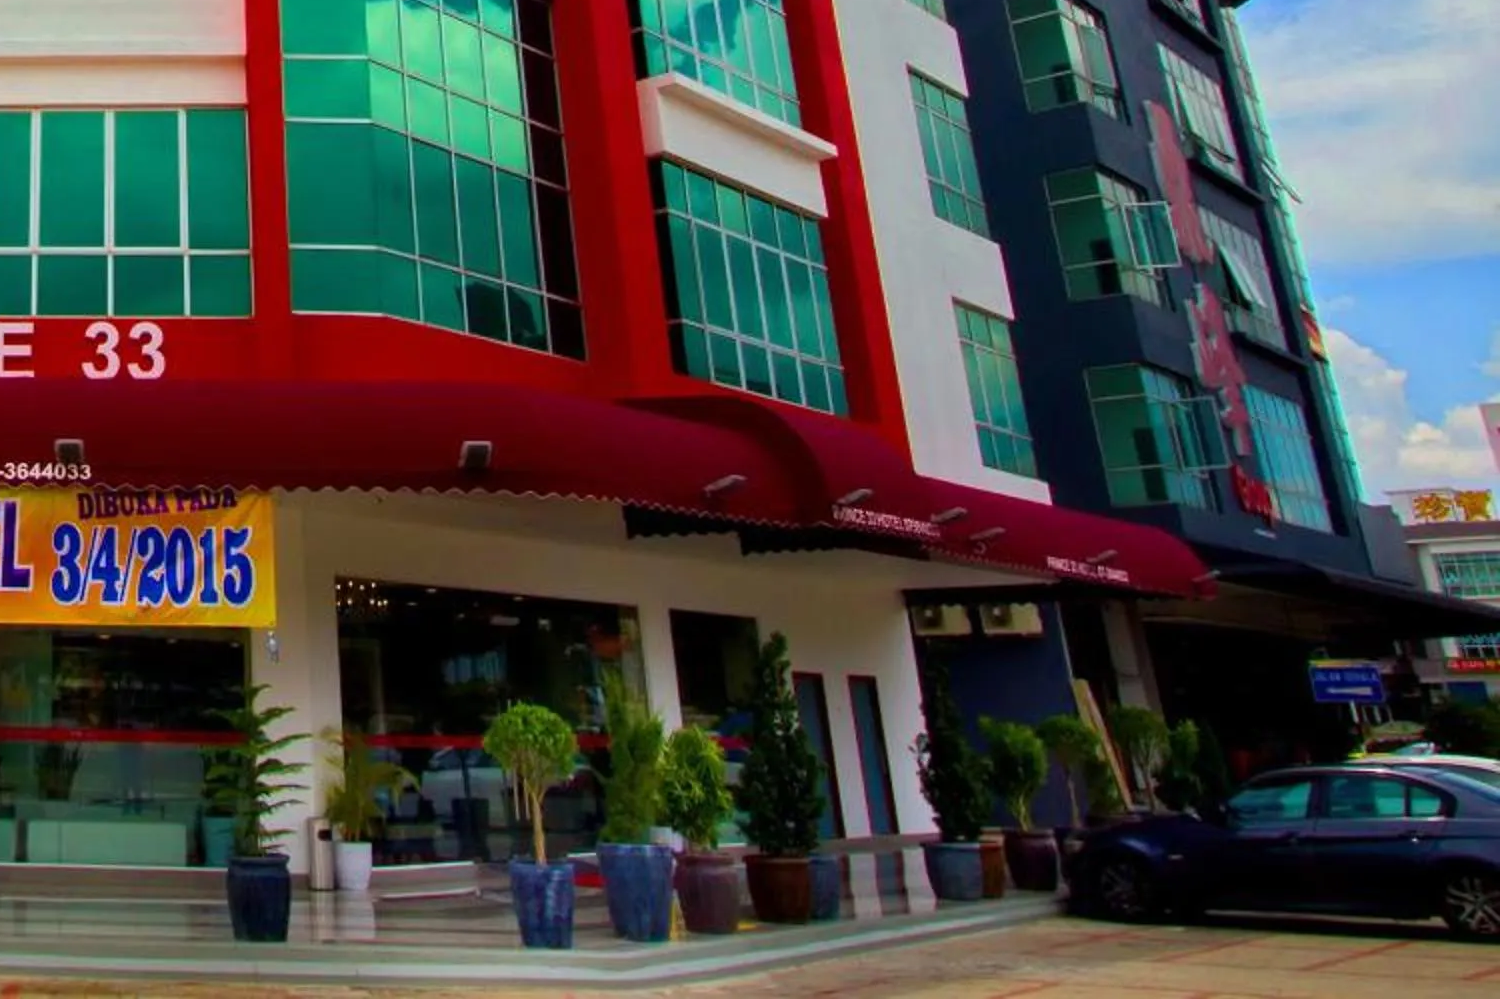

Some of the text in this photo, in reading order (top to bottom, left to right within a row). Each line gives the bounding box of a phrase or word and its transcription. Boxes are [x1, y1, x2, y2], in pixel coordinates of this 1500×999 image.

[81, 320, 167, 380] 33
[77, 490, 170, 520] DIBUKA
[49, 521, 255, 609] 3/4/2015
